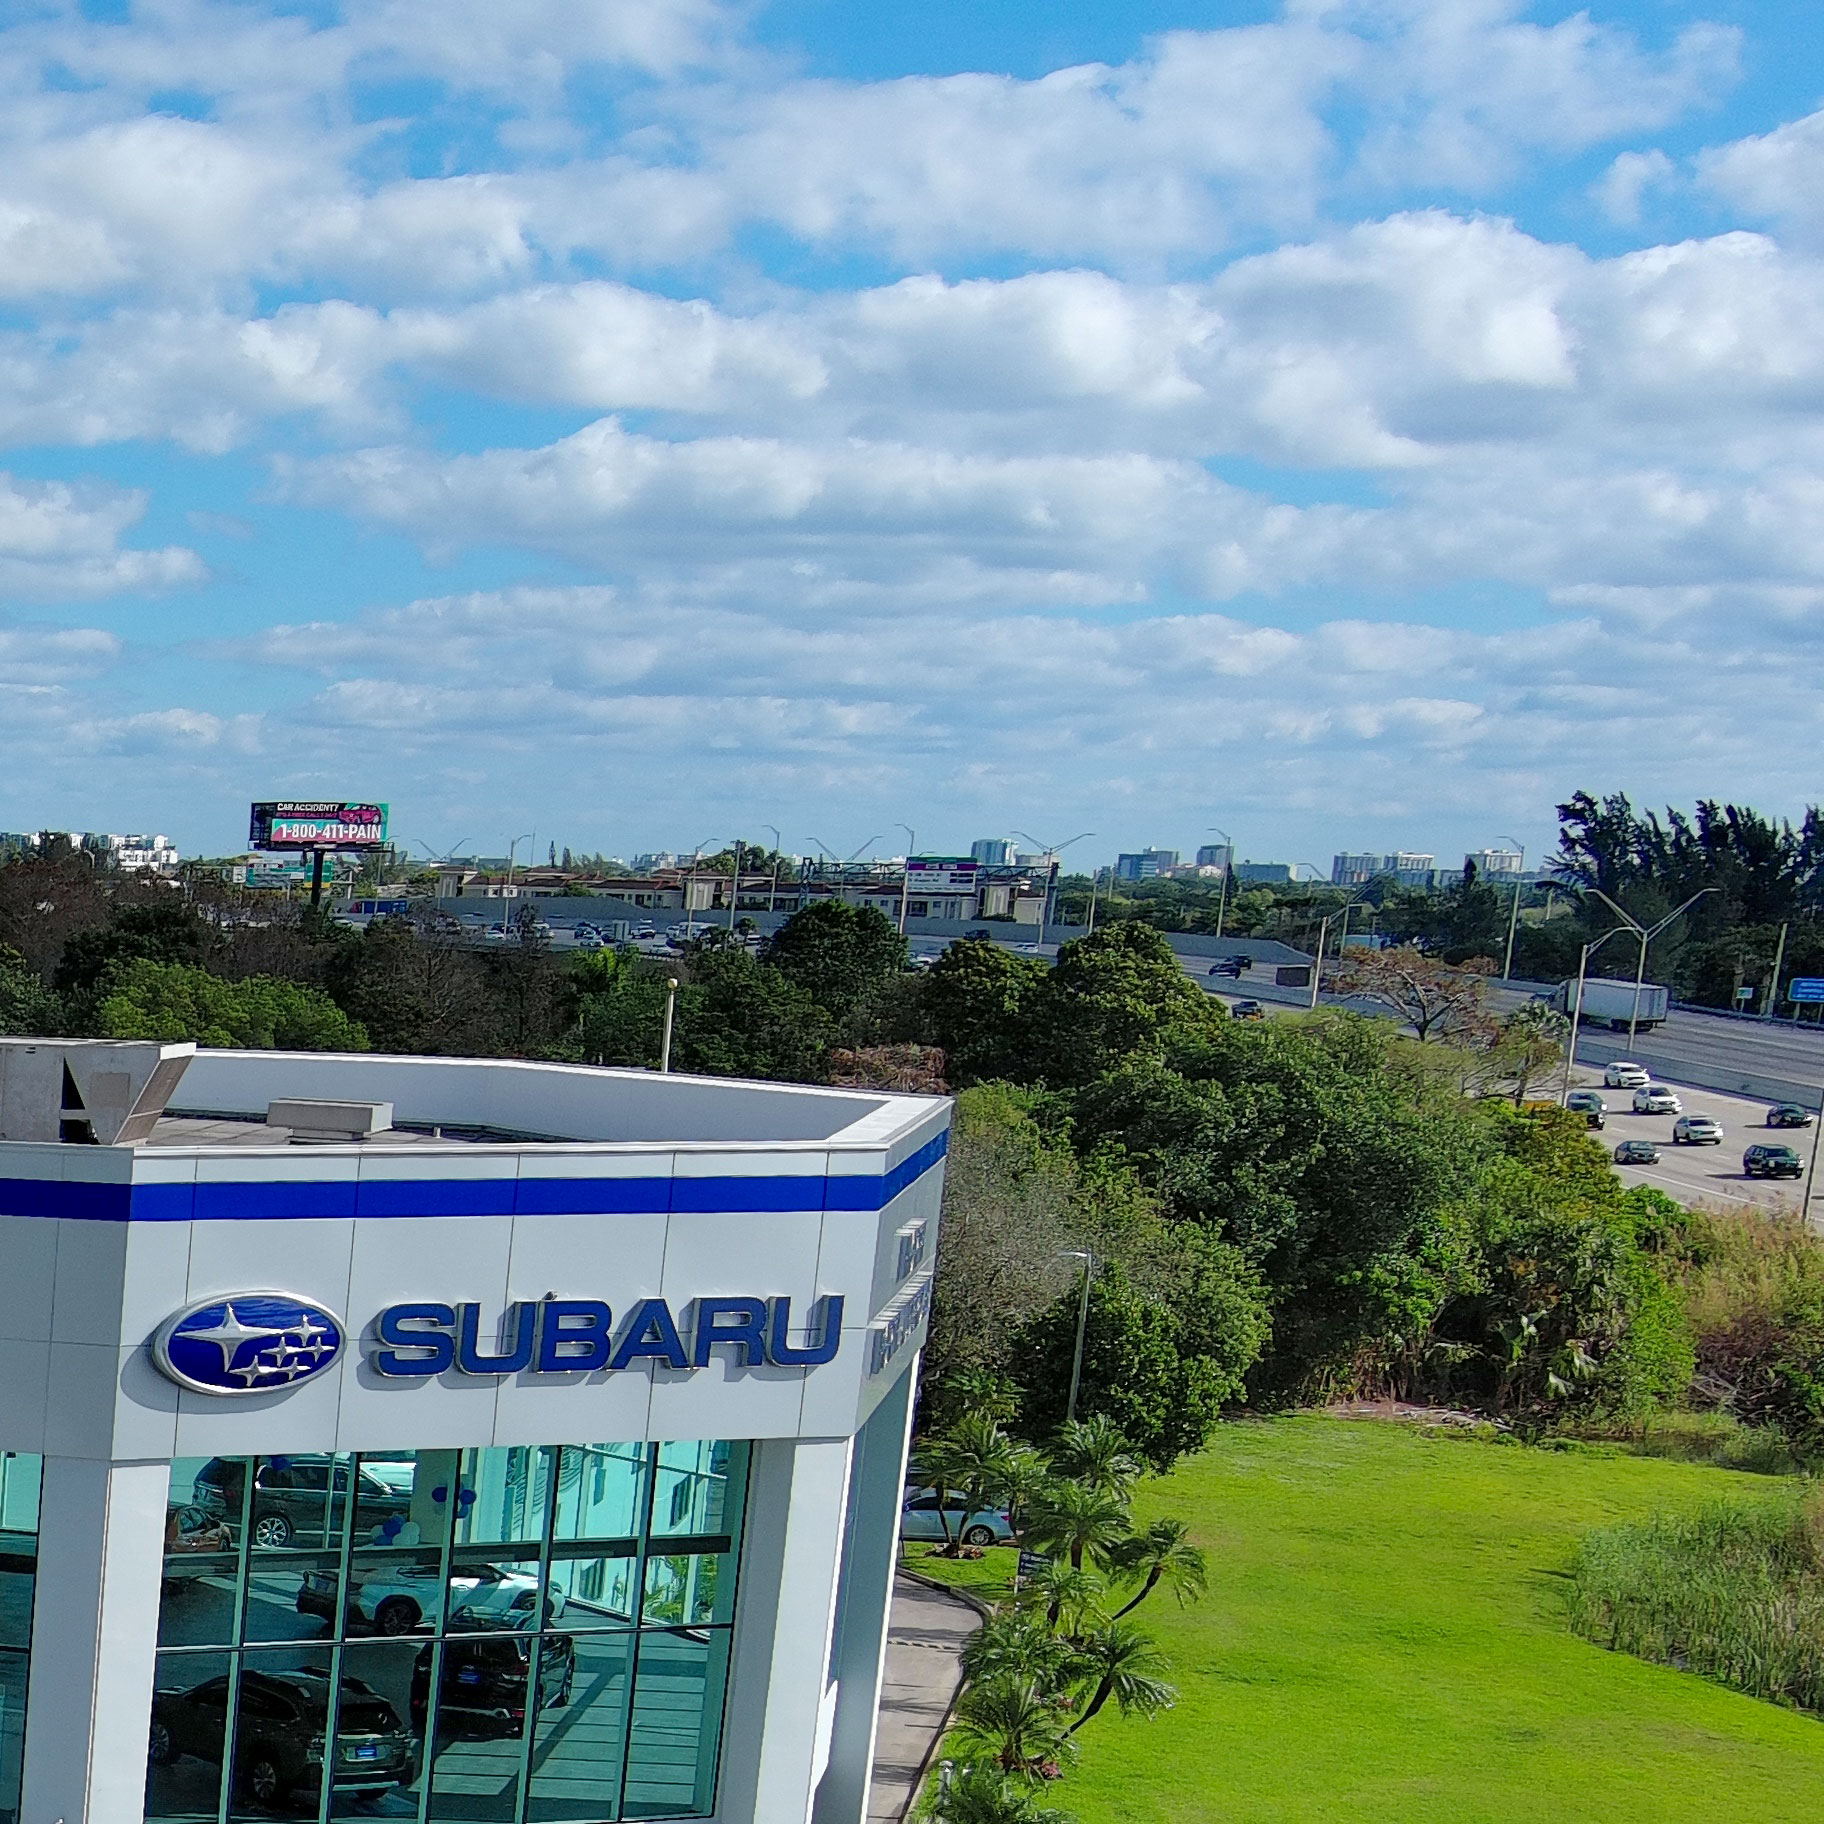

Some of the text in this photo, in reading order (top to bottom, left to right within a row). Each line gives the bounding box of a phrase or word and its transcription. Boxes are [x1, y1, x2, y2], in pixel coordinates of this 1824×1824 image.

[277, 803, 294, 811] CAR
[281, 824, 382, 838] 1-800-411-PAIN
[373, 1294, 845, 1377] SUBARU
